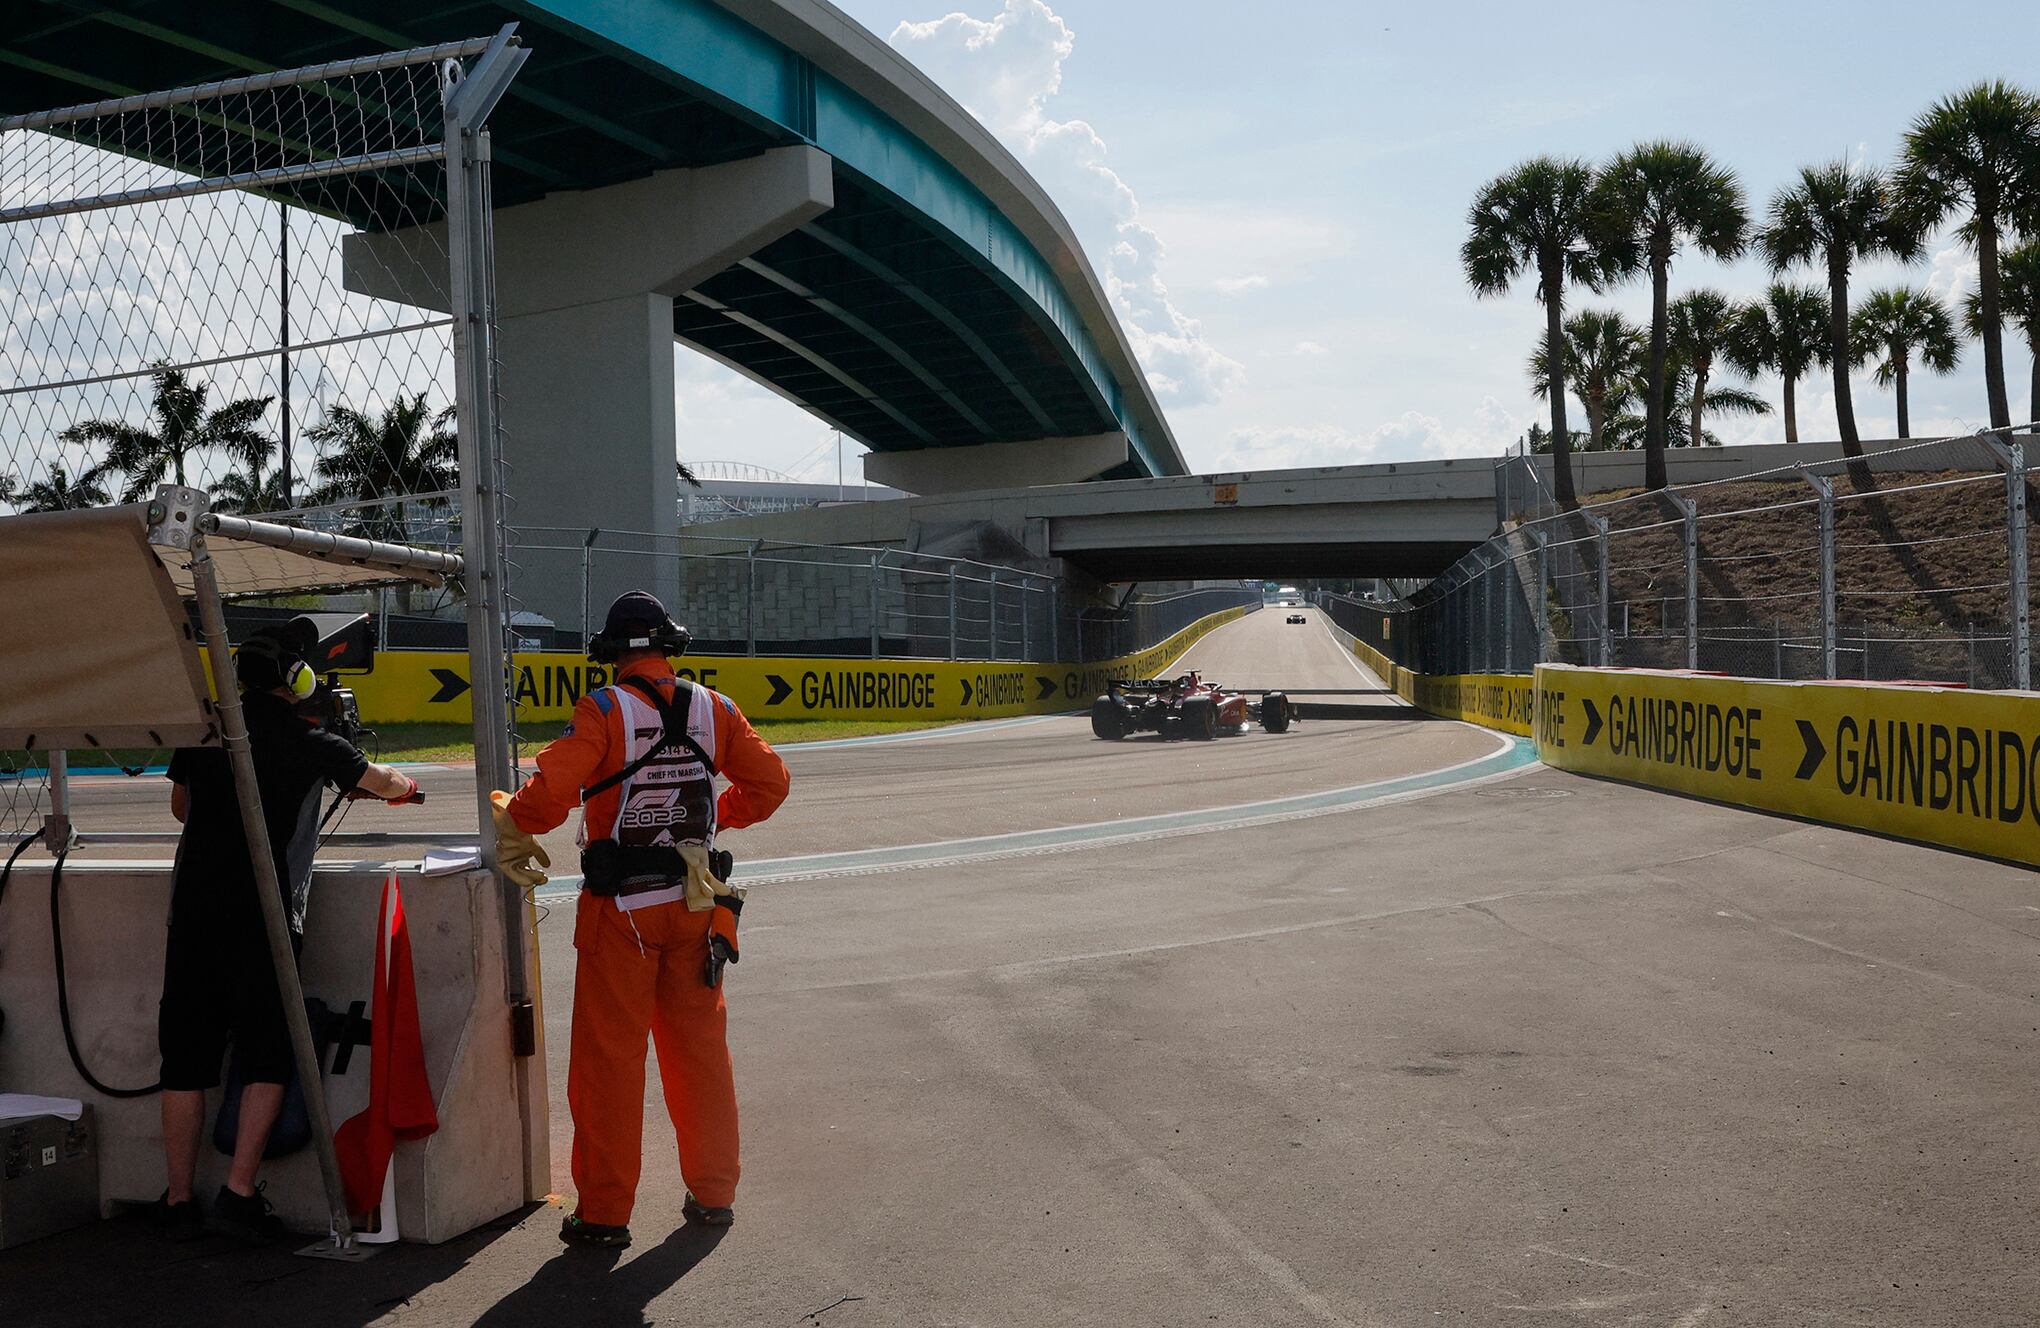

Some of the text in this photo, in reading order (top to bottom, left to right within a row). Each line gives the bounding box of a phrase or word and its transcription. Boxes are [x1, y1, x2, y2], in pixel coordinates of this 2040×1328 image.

[801, 671, 935, 709] GAINBRIDGE
[976, 672, 1025, 707] GAINBRIDGE
[1609, 694, 1762, 781] GAINBRIDGE
[647, 771, 666, 780] CHIEF
[622, 806, 688, 828] 2022
[44, 1150, 54, 1161] 14
